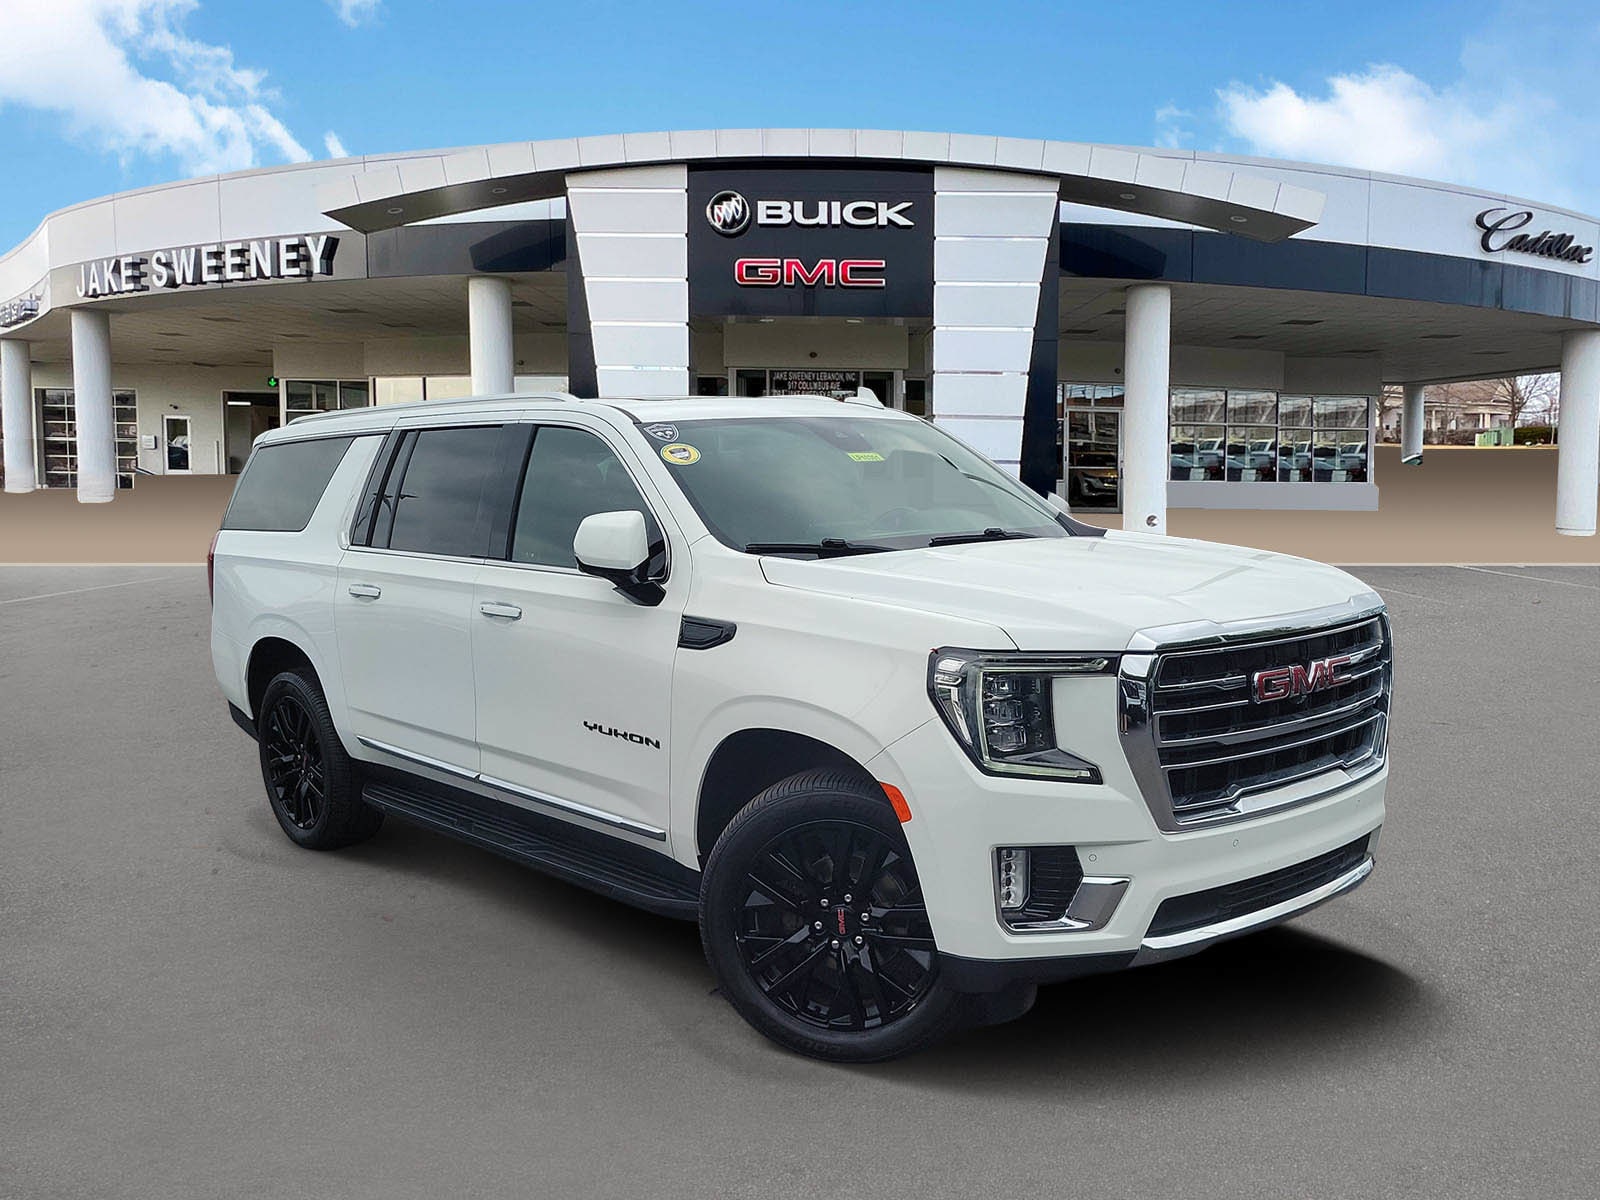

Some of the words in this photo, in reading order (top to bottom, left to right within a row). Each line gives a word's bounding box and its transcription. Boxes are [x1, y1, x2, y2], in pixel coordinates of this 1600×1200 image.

[757, 200, 915, 227] BUICK
[1475, 207, 1594, 264] Cadillac
[76, 255, 144, 299] JAKE
[151, 235, 335, 289] SWEENEY
[734, 258, 886, 287] GMC
[1253, 655, 1352, 704] GMC
[583, 720, 661, 750] YUKON
[837, 908, 846, 935] GMC
